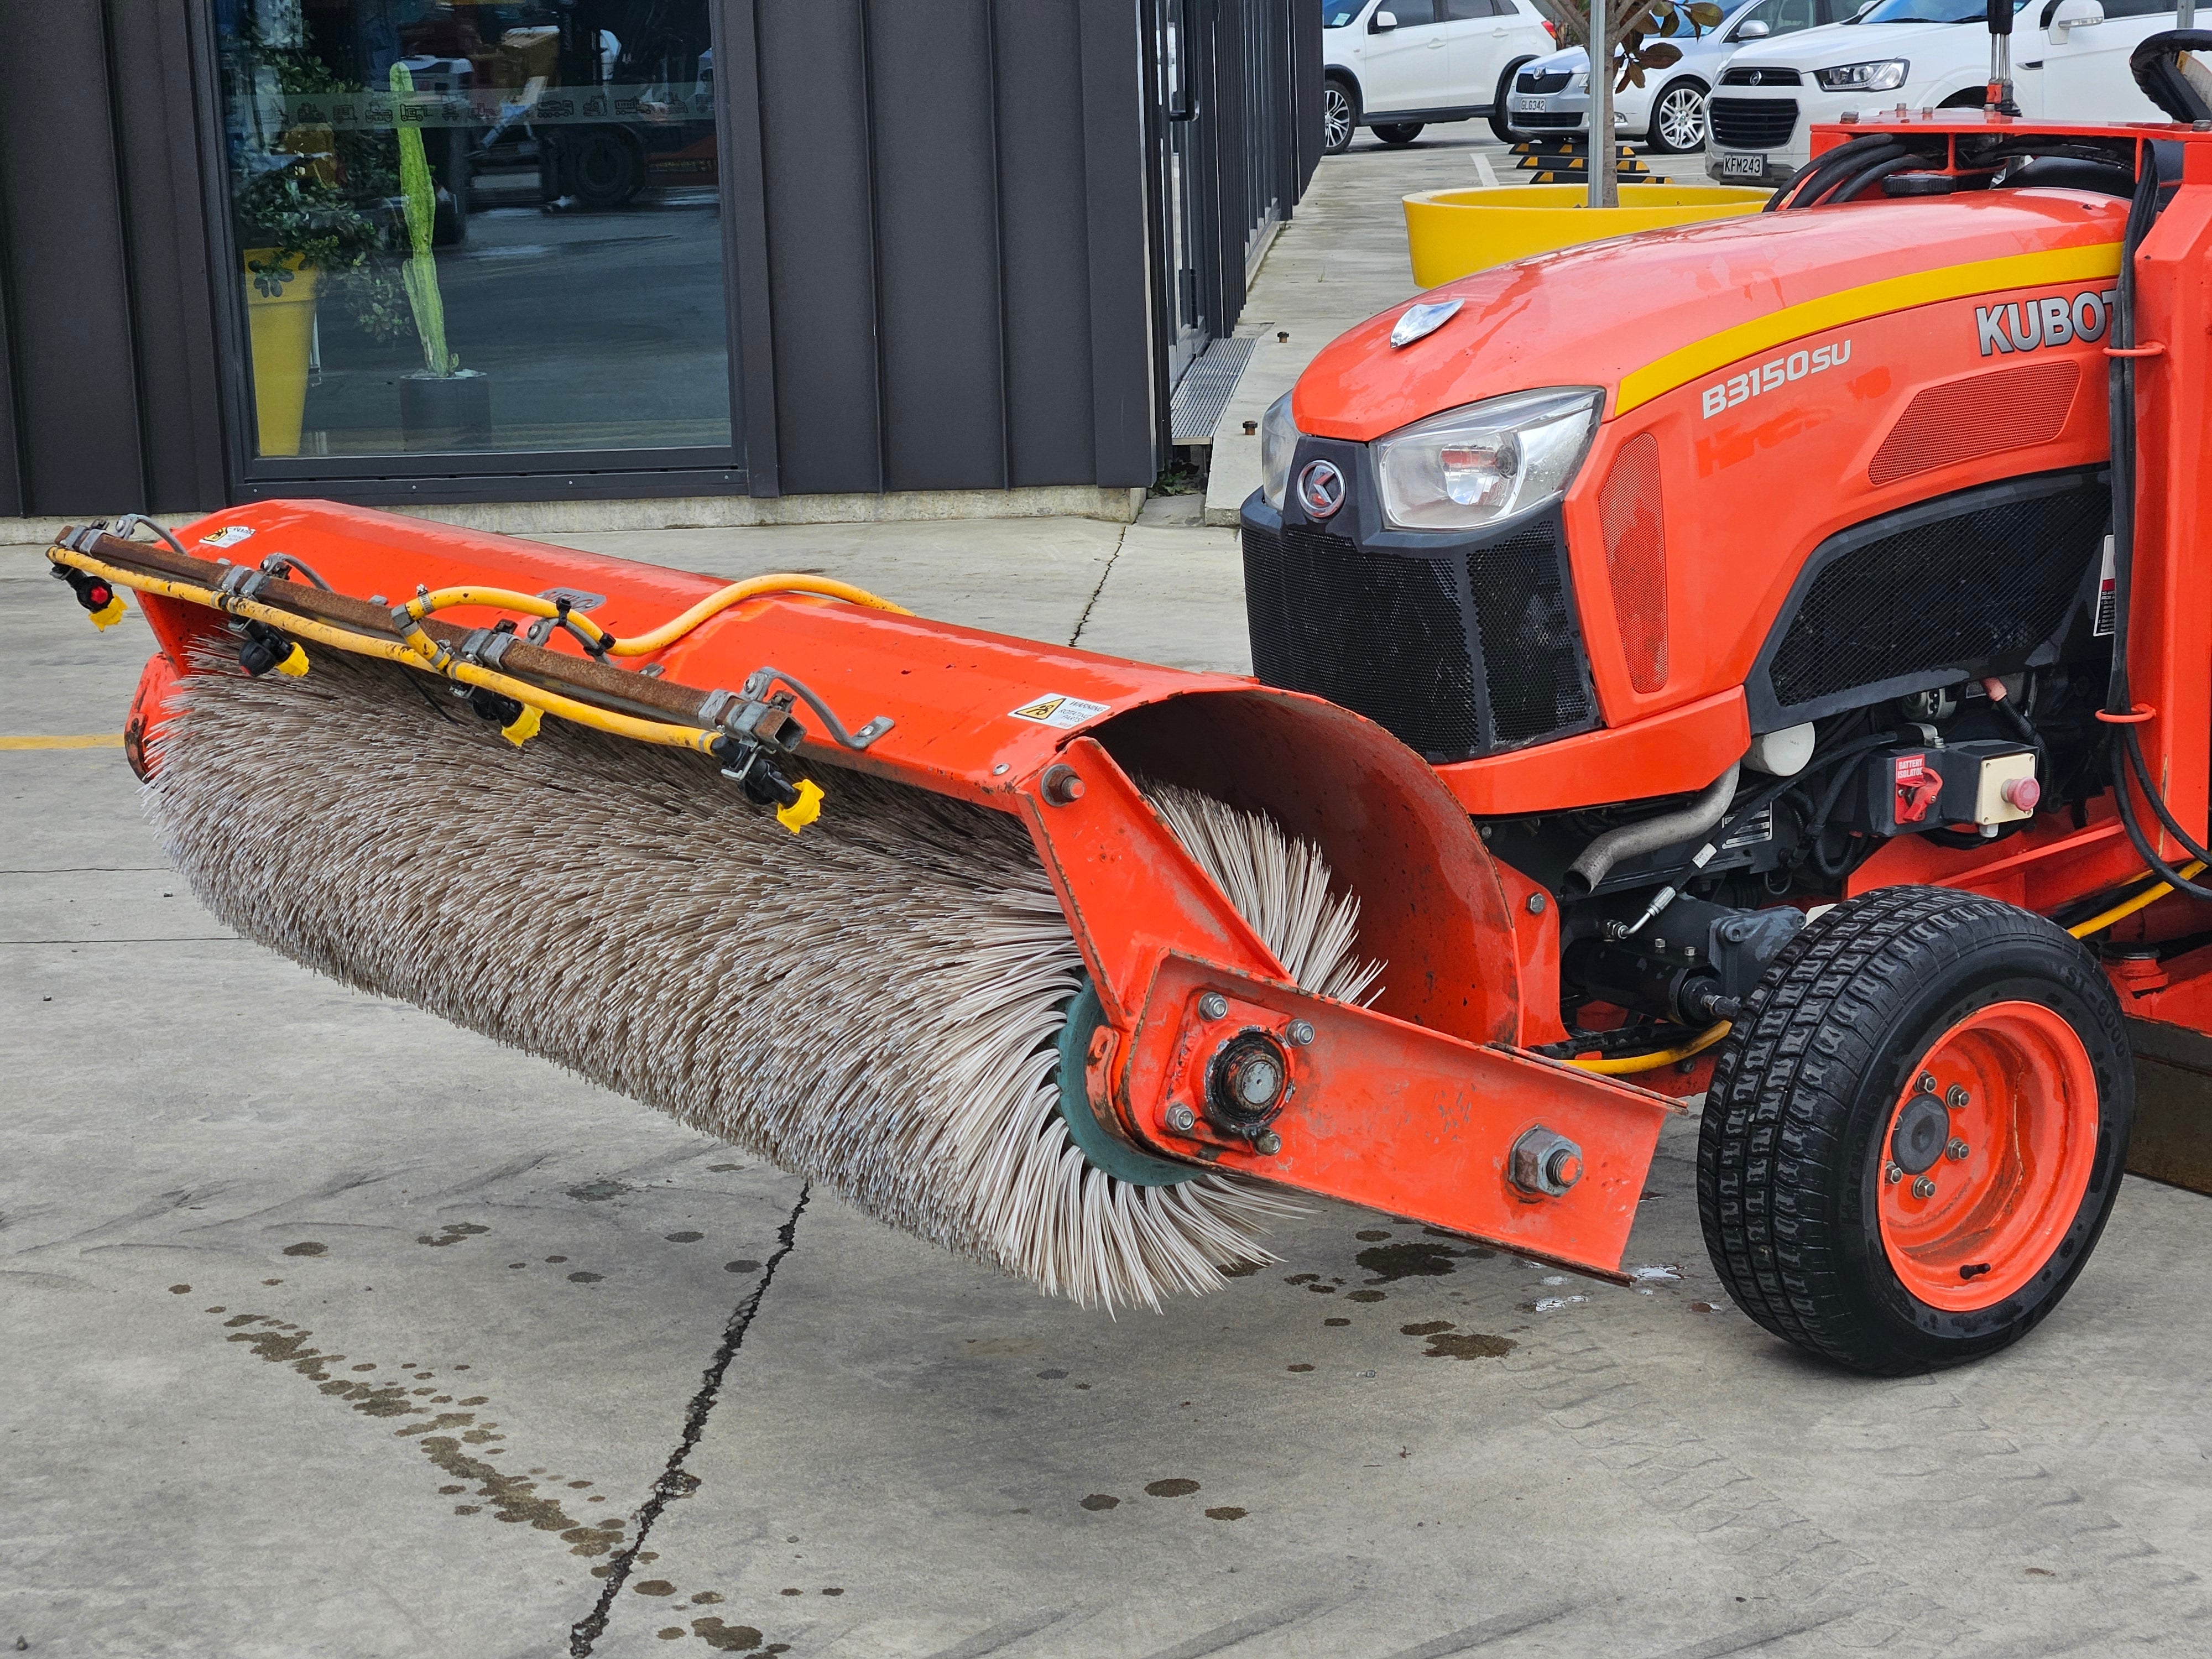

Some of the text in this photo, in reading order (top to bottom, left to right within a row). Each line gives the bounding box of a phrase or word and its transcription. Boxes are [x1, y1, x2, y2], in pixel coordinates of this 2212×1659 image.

[1725, 157, 1761, 173] KFM243
[1702, 339, 1851, 420] B3150SU
[1058, 708, 1092, 719] ROTATING
[1070, 701, 1107, 712] WARNING
[1898, 758, 1923, 770] BATTERY
[2066, 966, 2126, 1057] ST-6000
